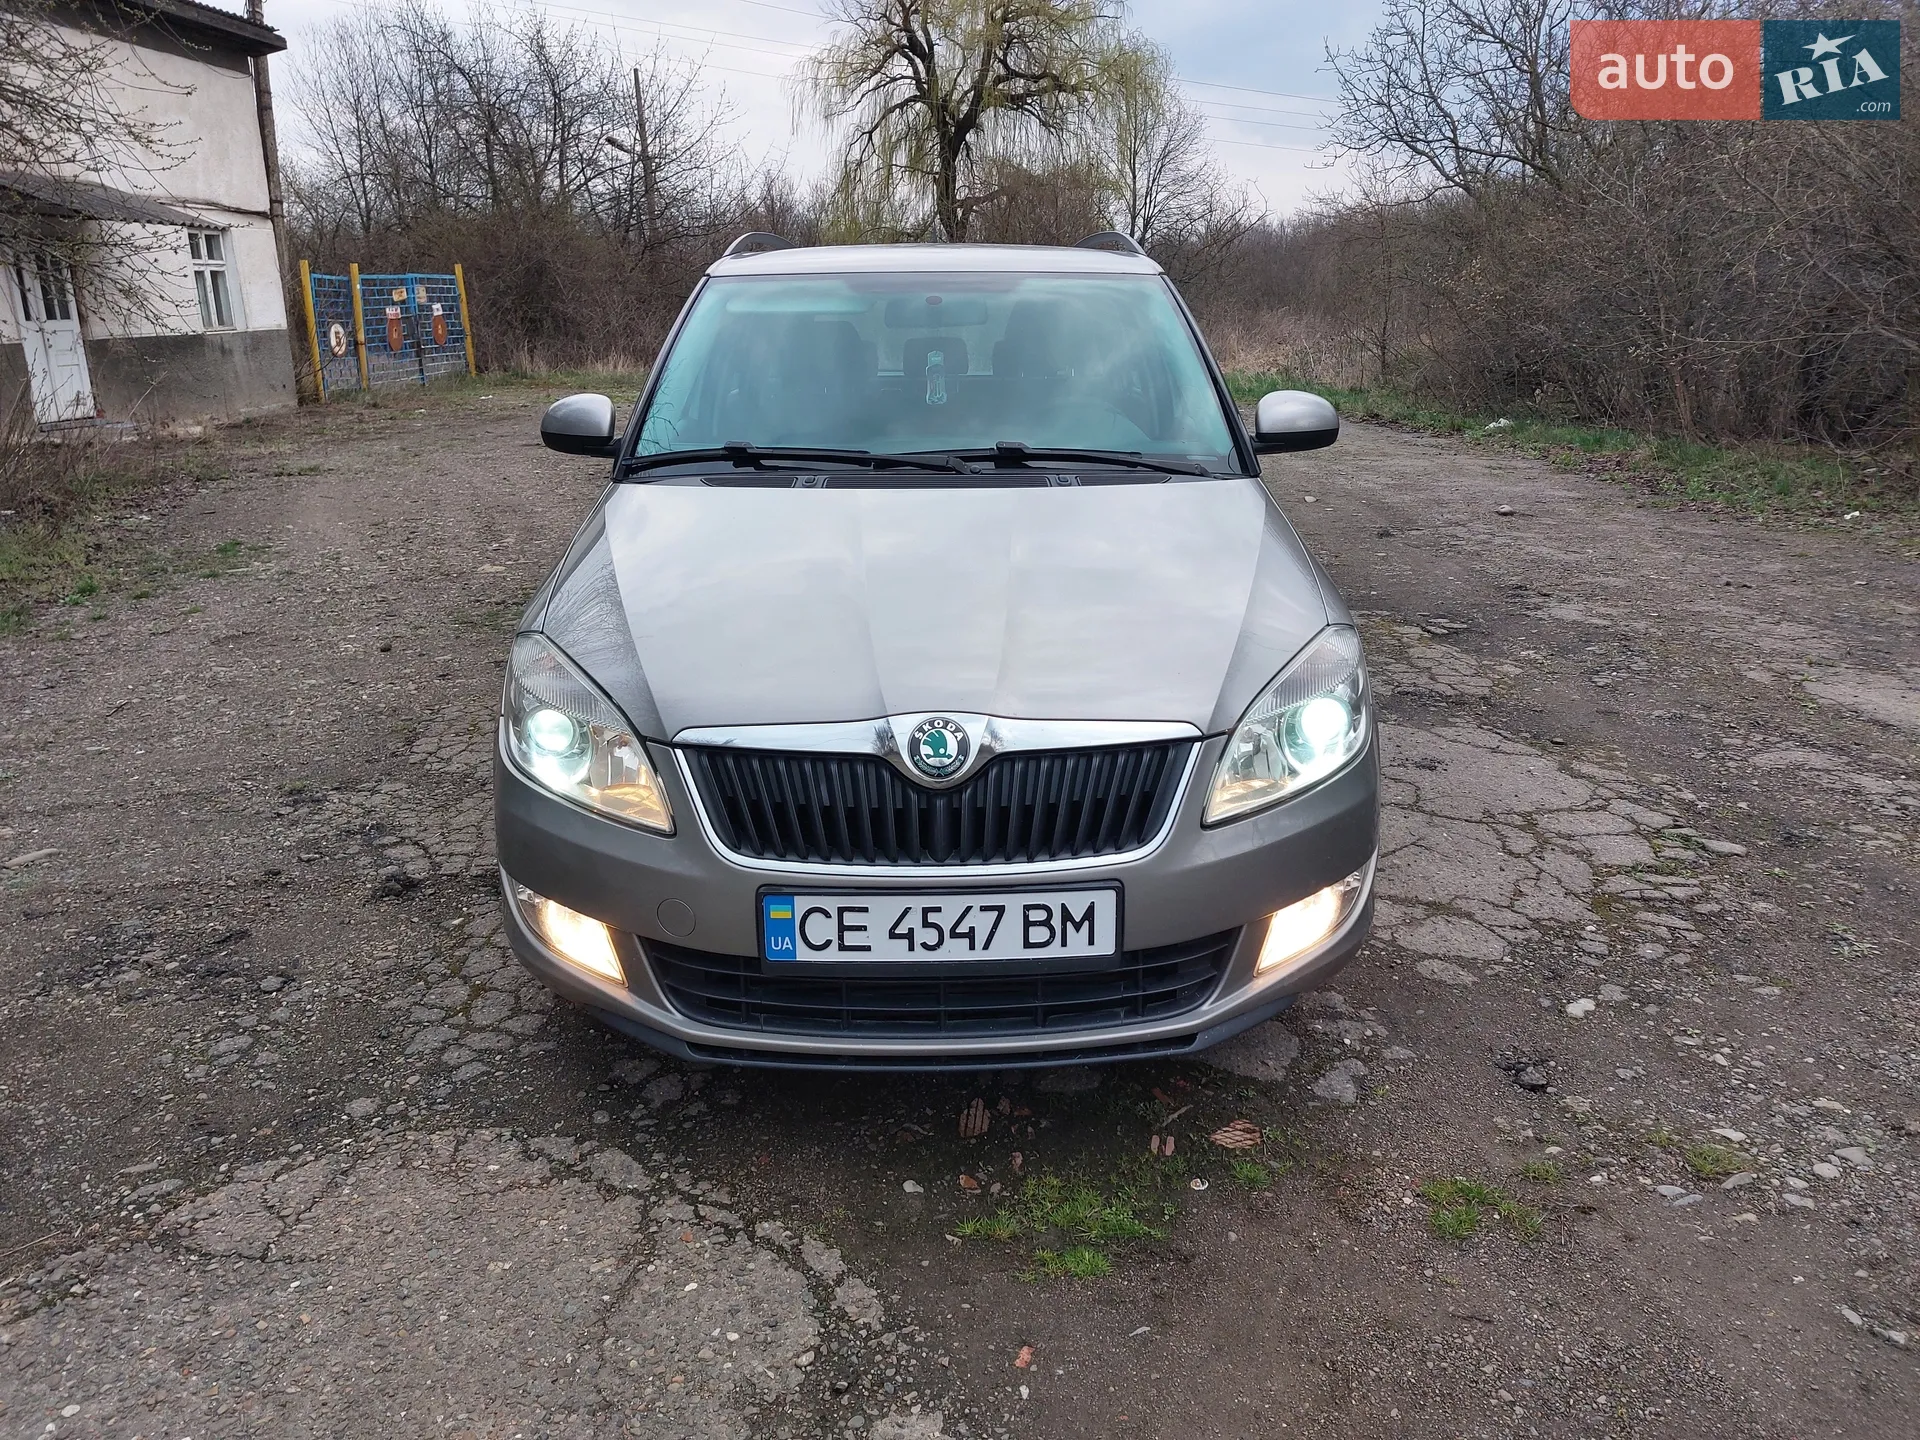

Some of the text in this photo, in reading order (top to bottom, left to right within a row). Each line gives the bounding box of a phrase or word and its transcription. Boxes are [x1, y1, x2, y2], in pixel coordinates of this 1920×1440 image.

[799, 901, 1095, 952] CE 4547 BM
[771, 936, 793, 951] UA
